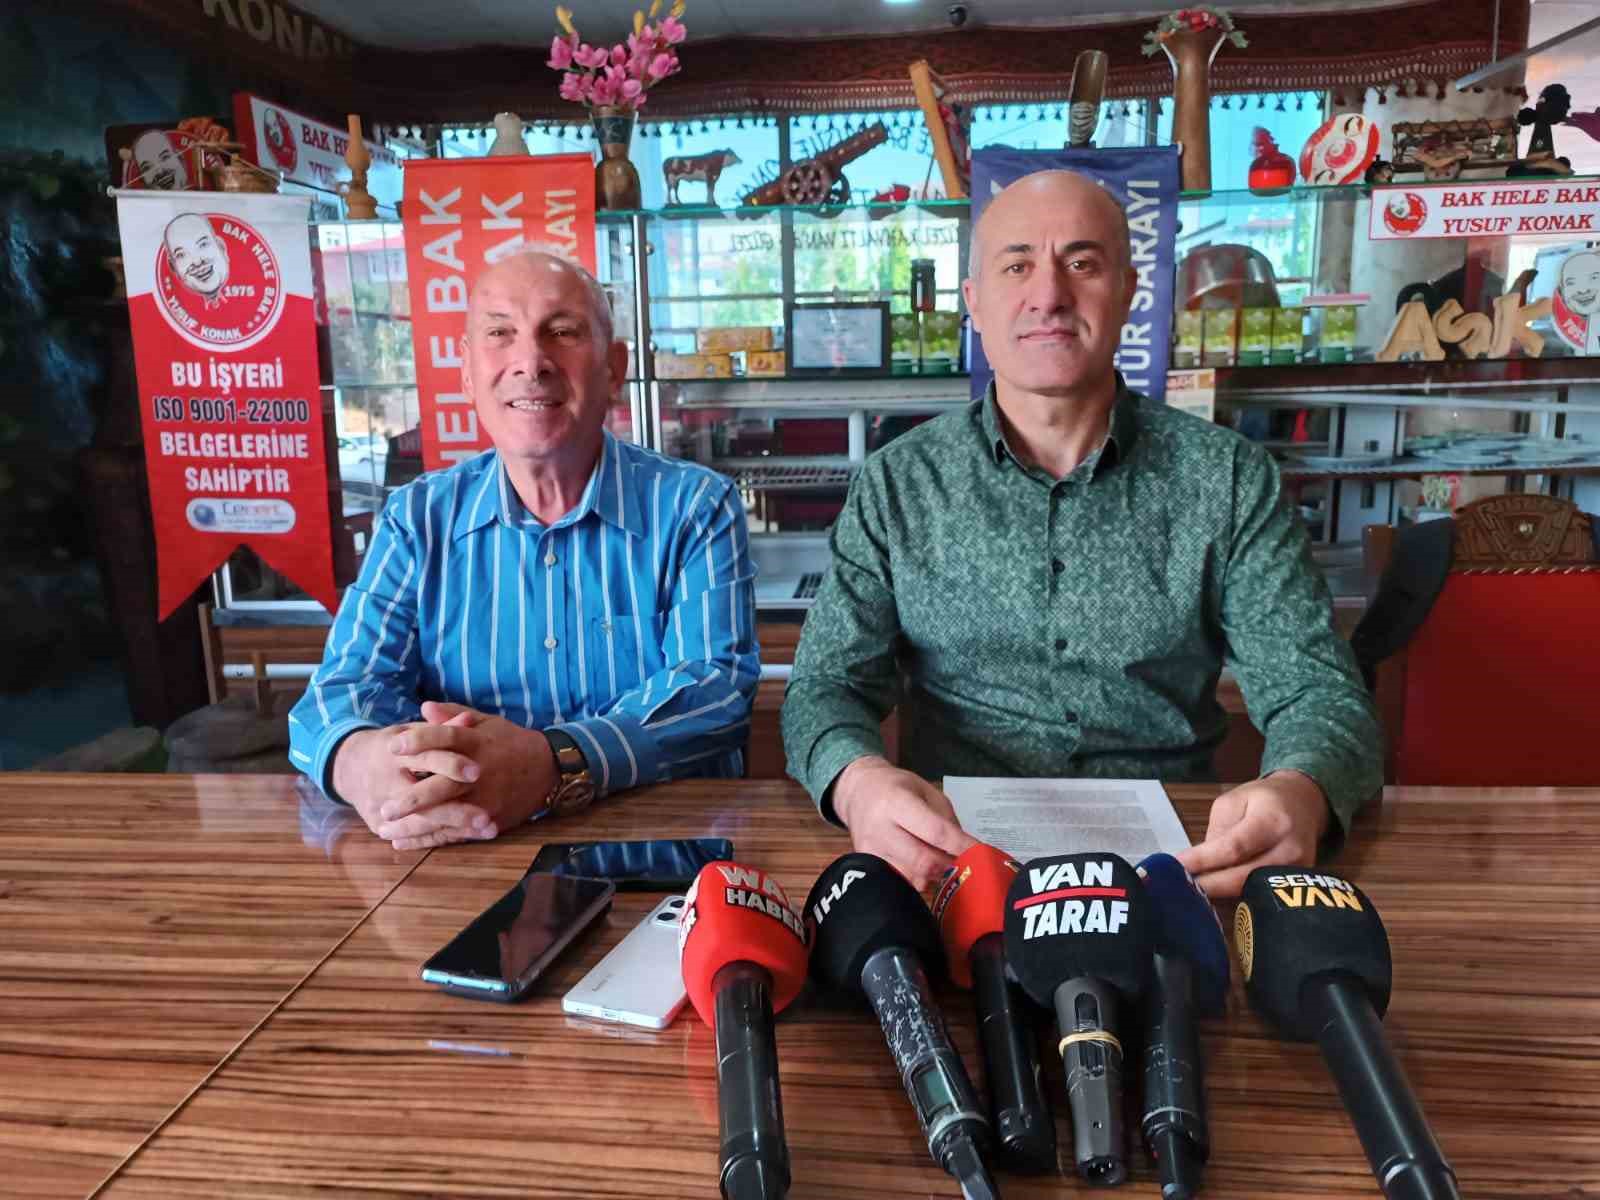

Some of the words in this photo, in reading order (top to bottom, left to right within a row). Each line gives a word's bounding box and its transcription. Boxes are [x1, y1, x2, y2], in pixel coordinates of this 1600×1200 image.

[1440, 191, 1486, 208] BAK
[1491, 188, 1549, 206] HELE
[1555, 186, 1600, 204] BAK
[222, 223, 249, 244] BAK
[1442, 216, 1512, 234] YUSUF
[1516, 214, 1595, 232] KONAK
[251, 243, 275, 280] HELE
[419, 187, 468, 313] BAK
[1127, 179, 1161, 314] SARAYI
[257, 286, 275, 316] BAK
[167, 296, 199, 329] YUSUF
[200, 325, 242, 340] KONAK
[171, 362, 202, 387] BU
[209, 356, 284, 395] İŞYERİ
[153, 397, 184, 421] ISO
[190, 398, 309, 422] 9001-22000
[160, 428, 309, 459] BELGELERİNE
[185, 463, 290, 492] SAHİPTİR
[1029, 861, 1113, 894] VAN
[1272, 886, 1364, 912] VAN
[1022, 901, 1130, 940] TARAF
